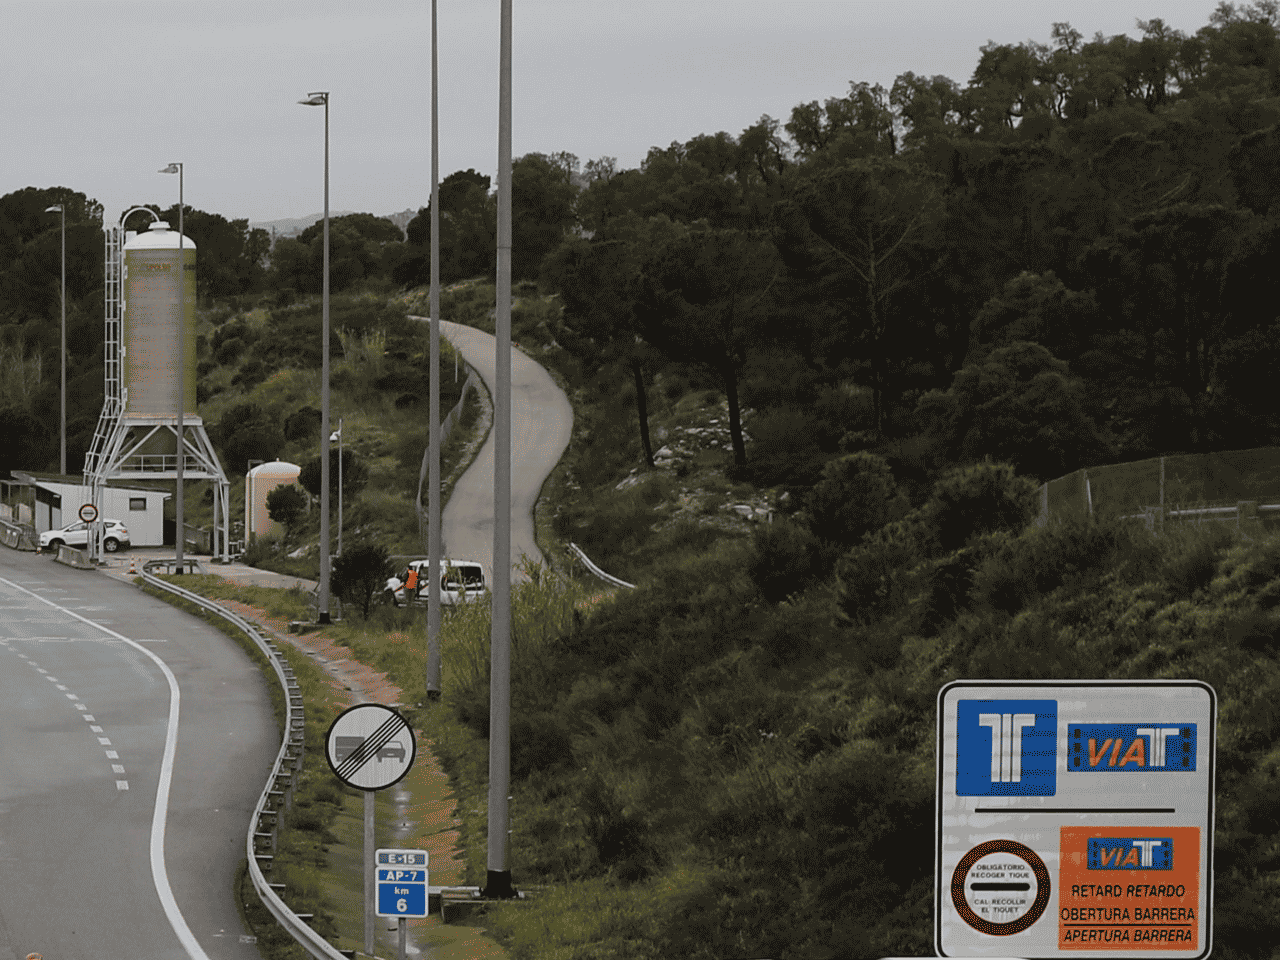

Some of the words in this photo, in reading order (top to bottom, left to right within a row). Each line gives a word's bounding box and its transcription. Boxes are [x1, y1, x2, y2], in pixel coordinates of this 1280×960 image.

[386, 871, 418, 882] AP-7
[394, 886, 410, 895] km
[1071, 884, 1123, 898] RETARD
[1126, 884, 1186, 898] RETARDO
[396, 898, 408, 913] 6
[1060, 907, 1131, 921] OBERTURA
[1134, 907, 1196, 921] BARRERA
[1063, 929, 1130, 942] APERTURA
[1133, 929, 1192, 942] BARRERA
